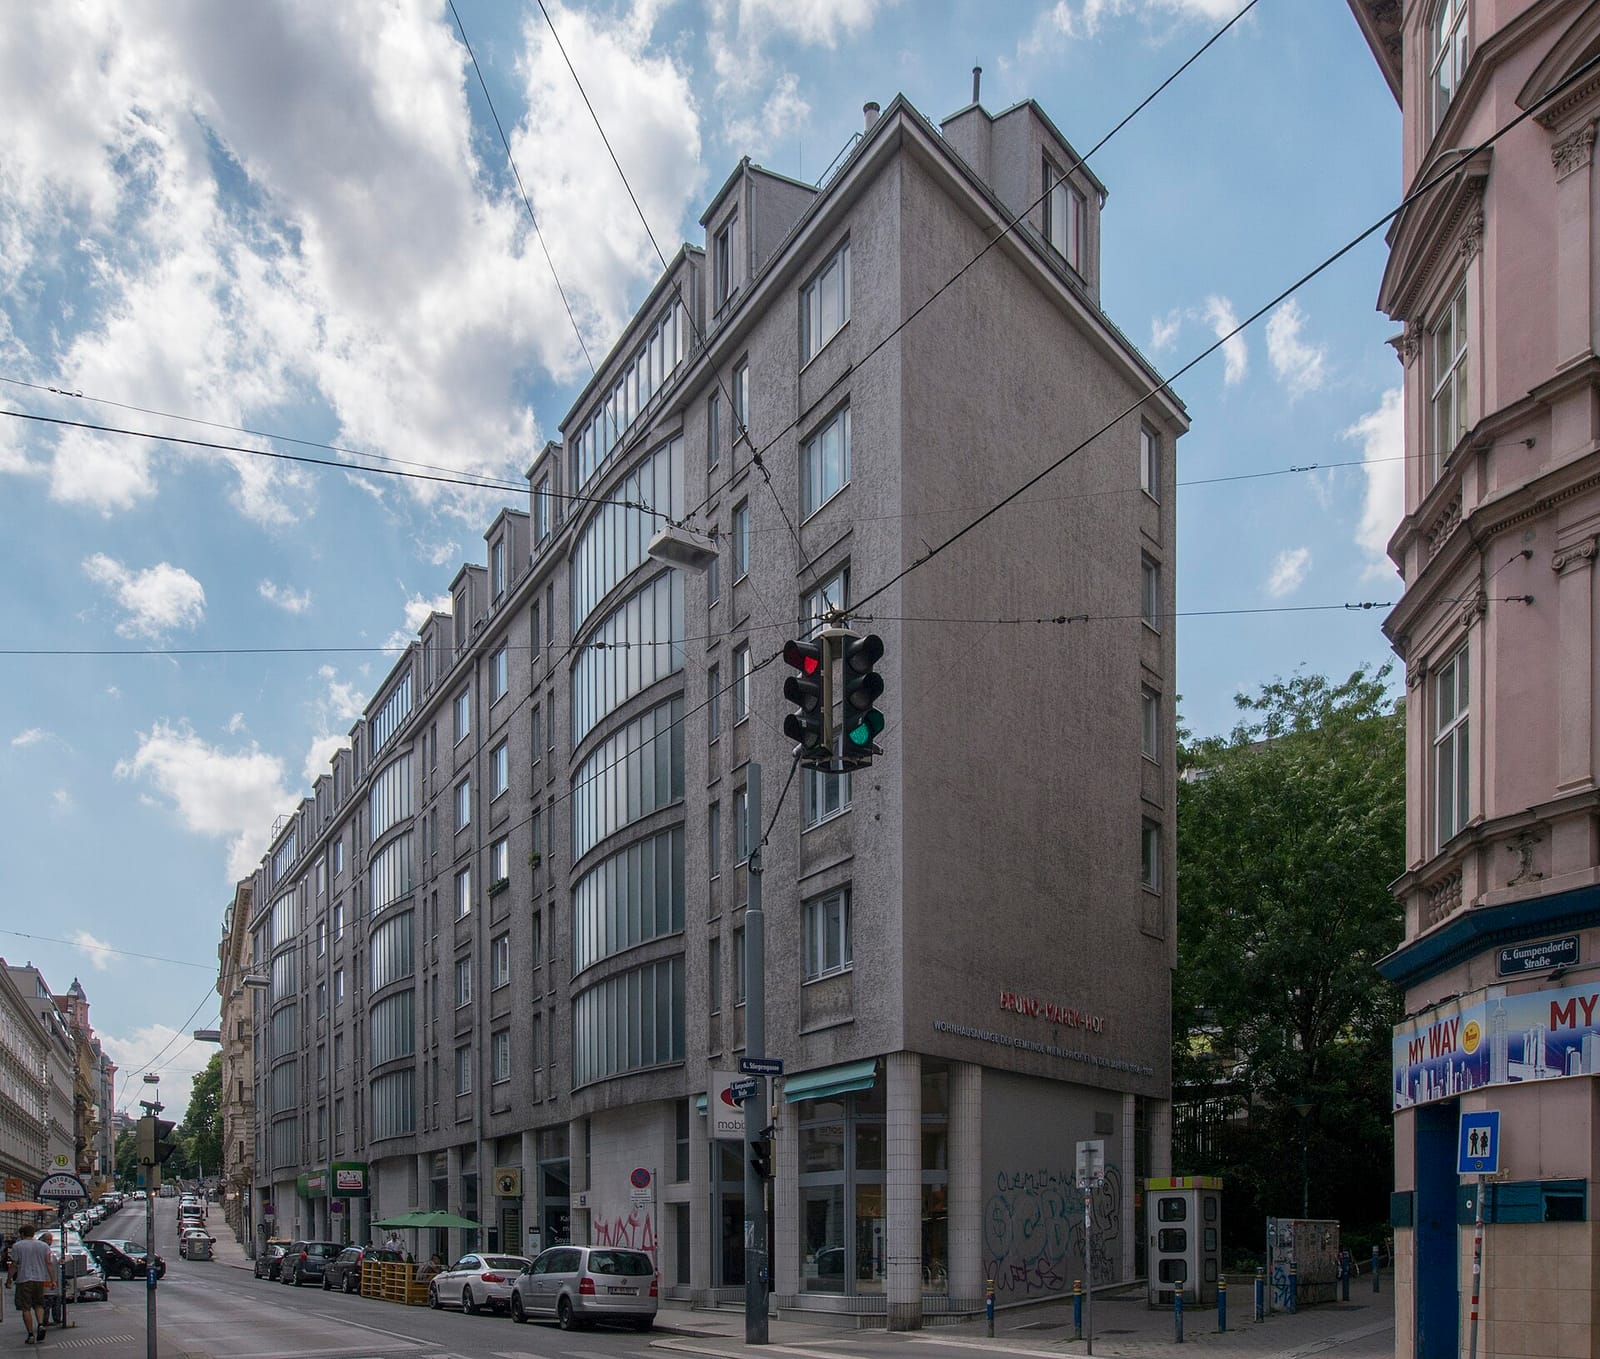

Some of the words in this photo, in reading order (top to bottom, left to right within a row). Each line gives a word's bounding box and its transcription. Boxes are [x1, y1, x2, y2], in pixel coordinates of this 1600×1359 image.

[1513, 941, 1574, 959] Gumpendorfer
[1524, 956, 1551, 968] Straße
[1550, 994, 1599, 1032] MY
[934, 1019, 999, 1043] WOHNHAUSANLAGE
[1408, 1036, 1426, 1066] MY
[1428, 1016, 1460, 1059] WAY
[48, 1176, 76, 1186] AUTOBUS
